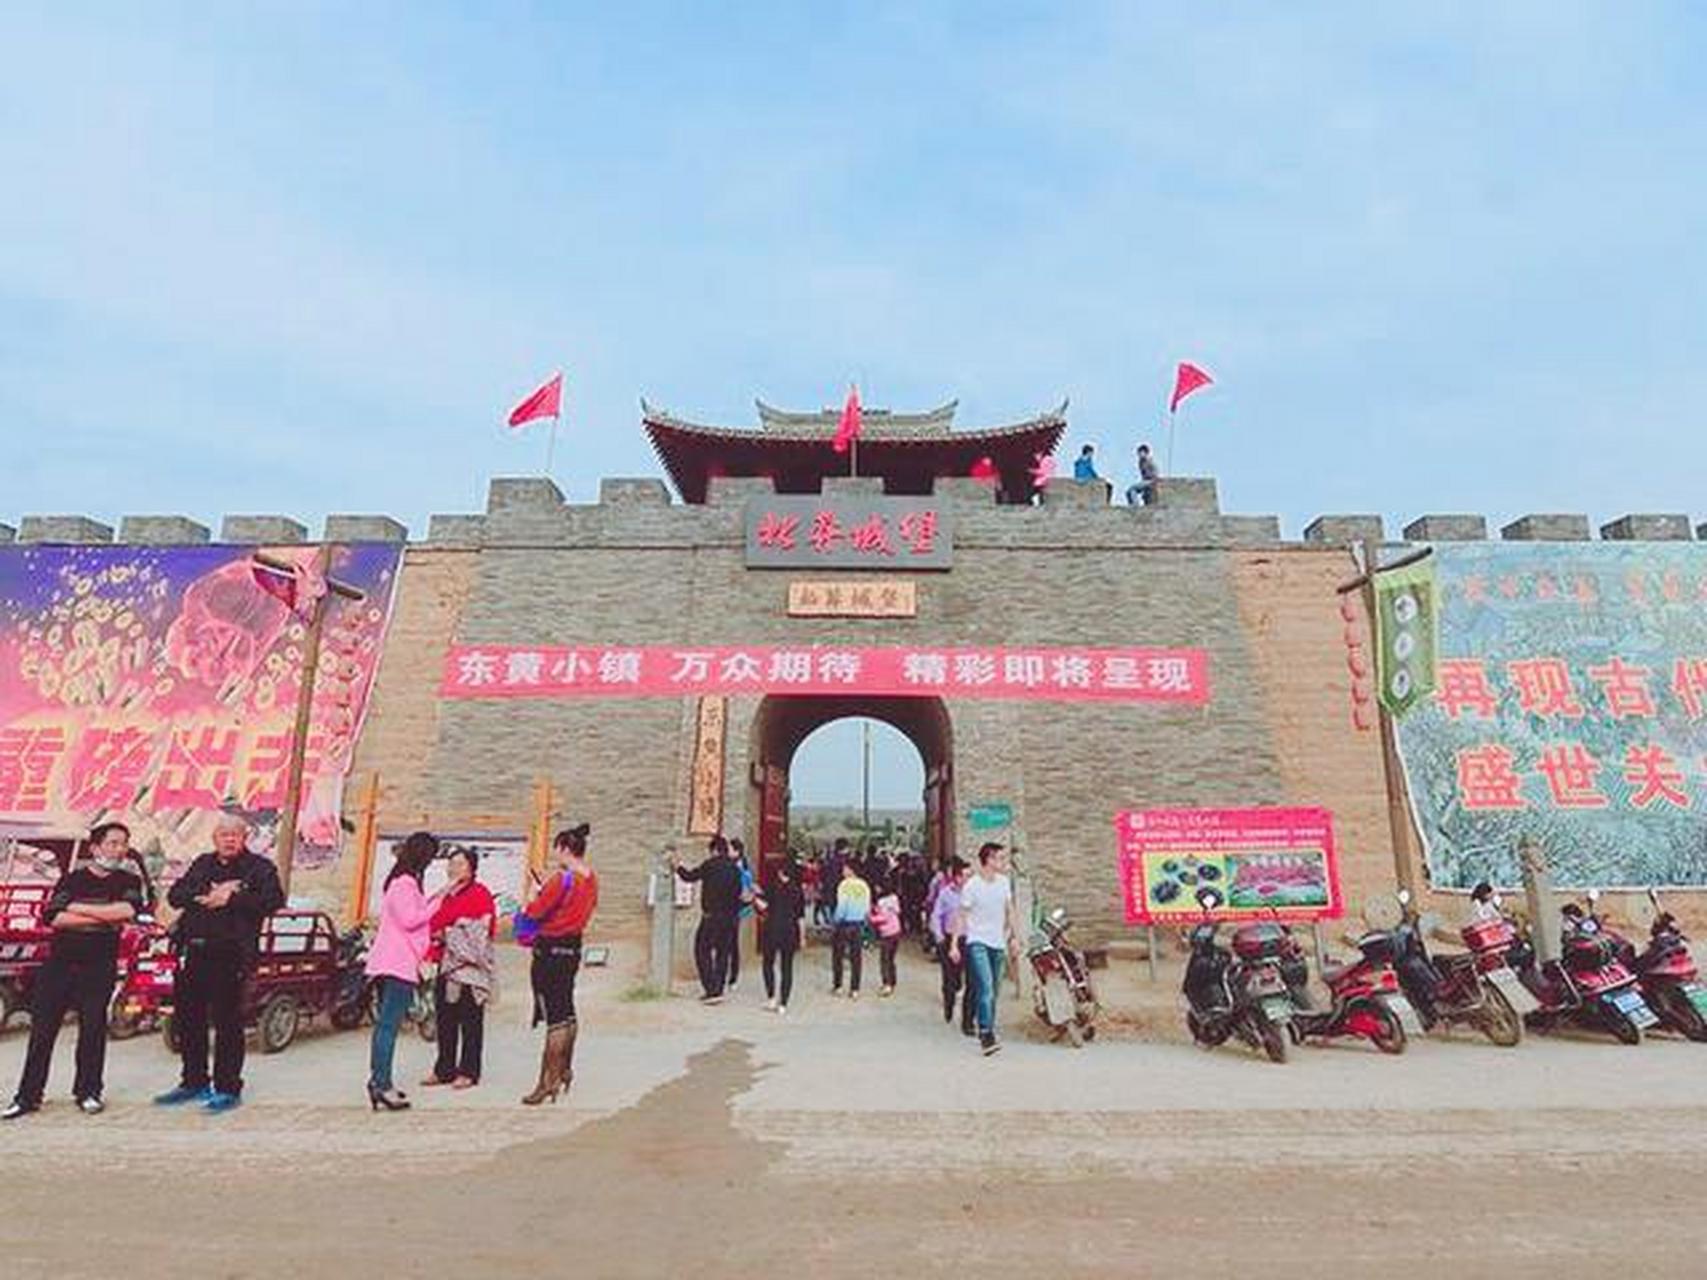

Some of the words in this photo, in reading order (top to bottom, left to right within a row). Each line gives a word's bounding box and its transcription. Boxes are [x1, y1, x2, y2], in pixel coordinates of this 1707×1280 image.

[457, 651, 641, 684] 东黄小镇
[671, 652, 861, 683] 万众期待
[904, 653, 1192, 692] 精彩即将呈现
[1457, 744, 1707, 810] 盛世关
